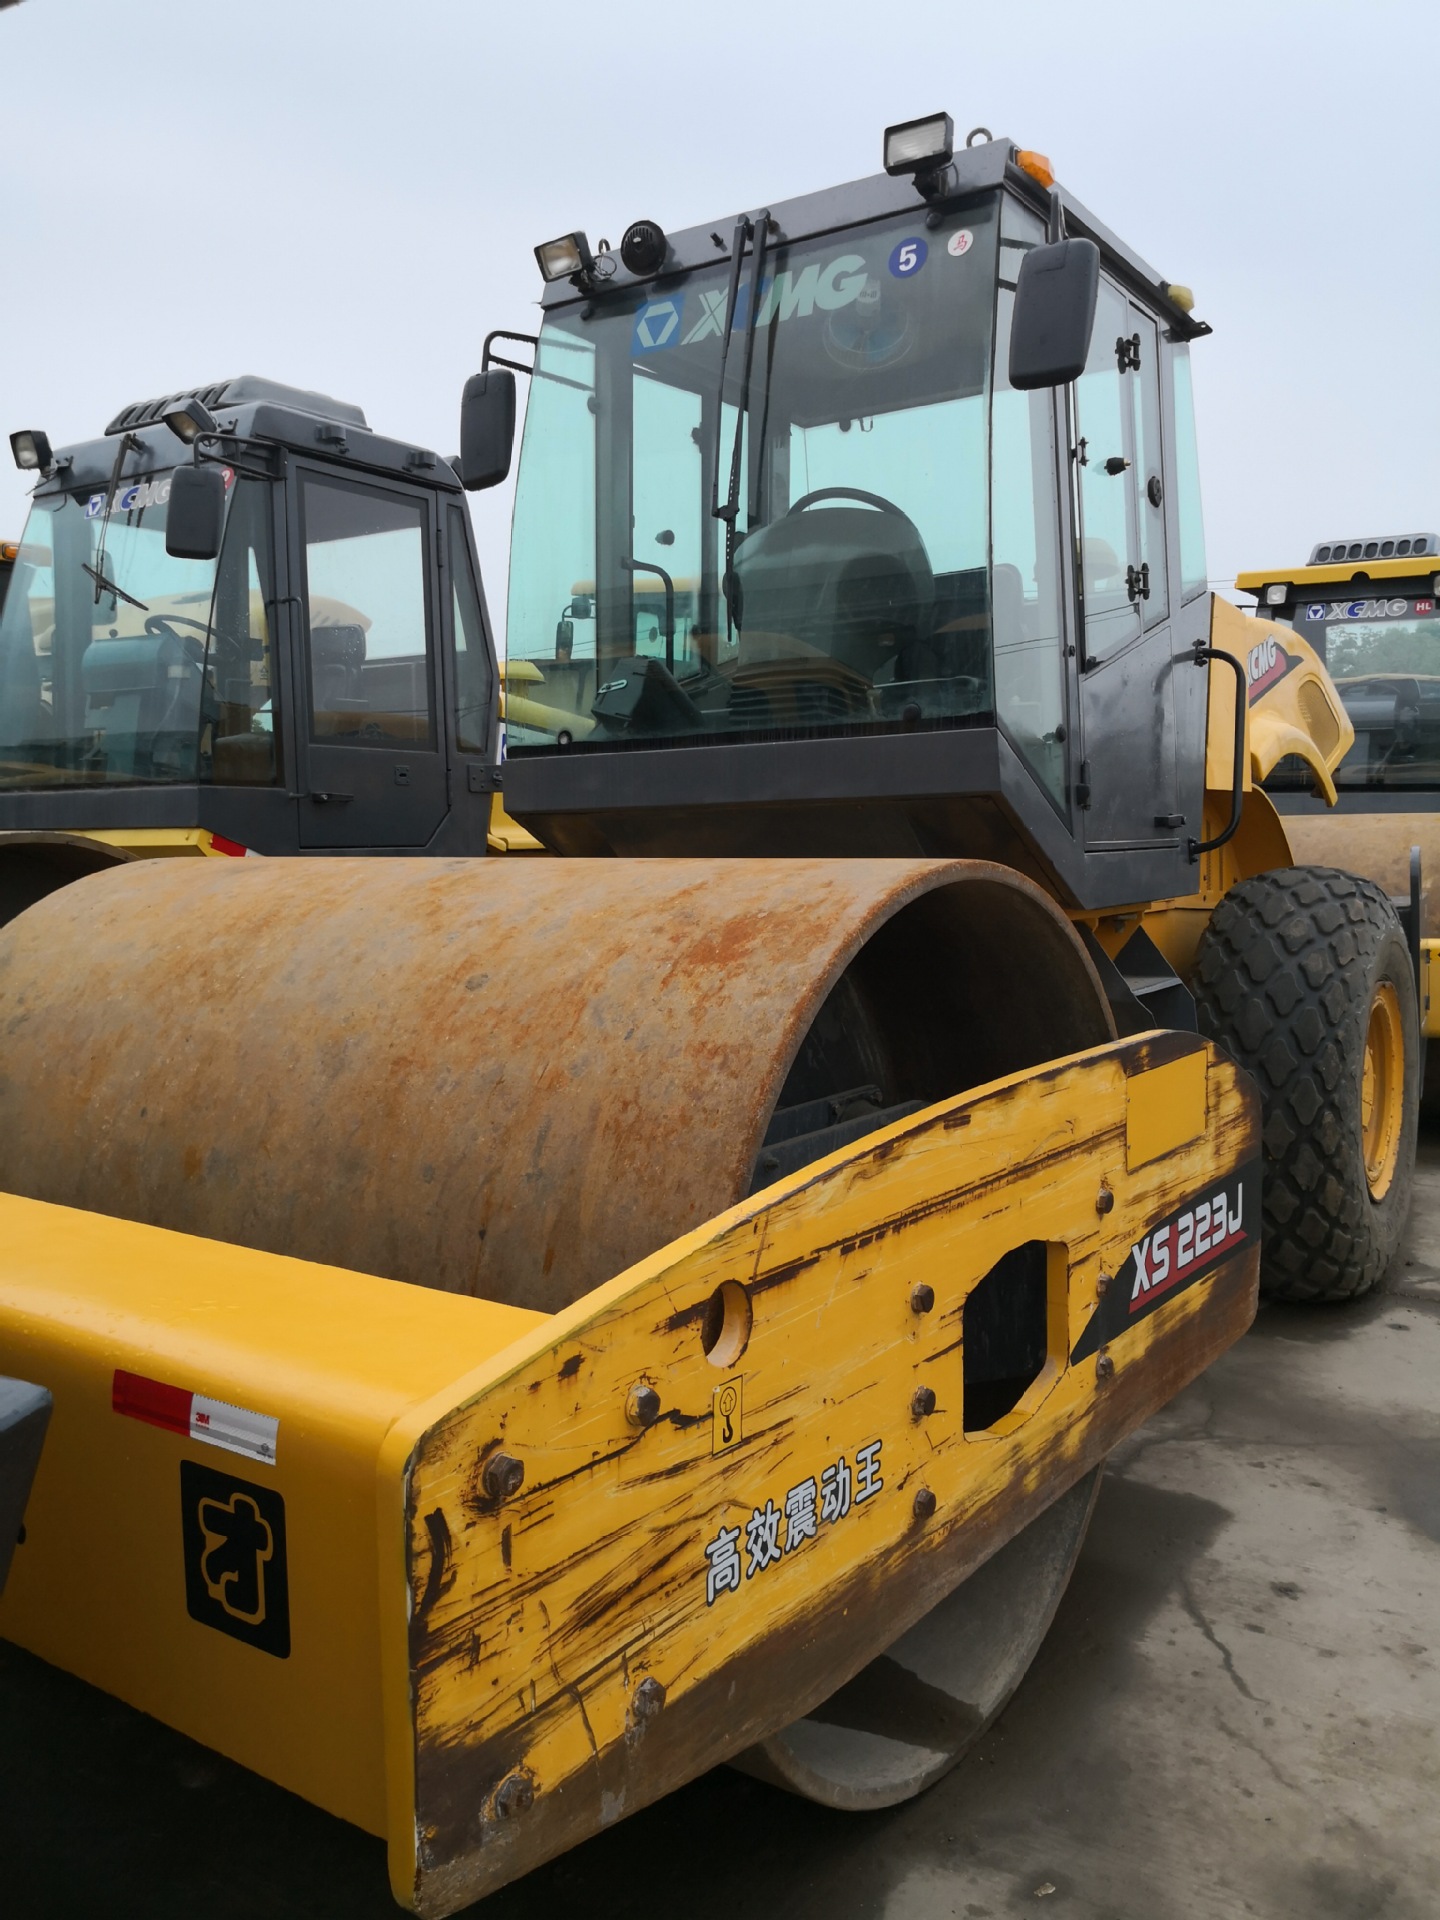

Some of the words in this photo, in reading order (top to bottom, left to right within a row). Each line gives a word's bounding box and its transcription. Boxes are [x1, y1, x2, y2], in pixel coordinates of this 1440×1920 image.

[898, 243, 918, 272] 5
[1325, 598, 1408, 620] XCMG
[1416, 602, 1432, 612] HL
[195, 1411, 210, 1425] 3M
[705, 1439, 884, 1607] 高效震动王
